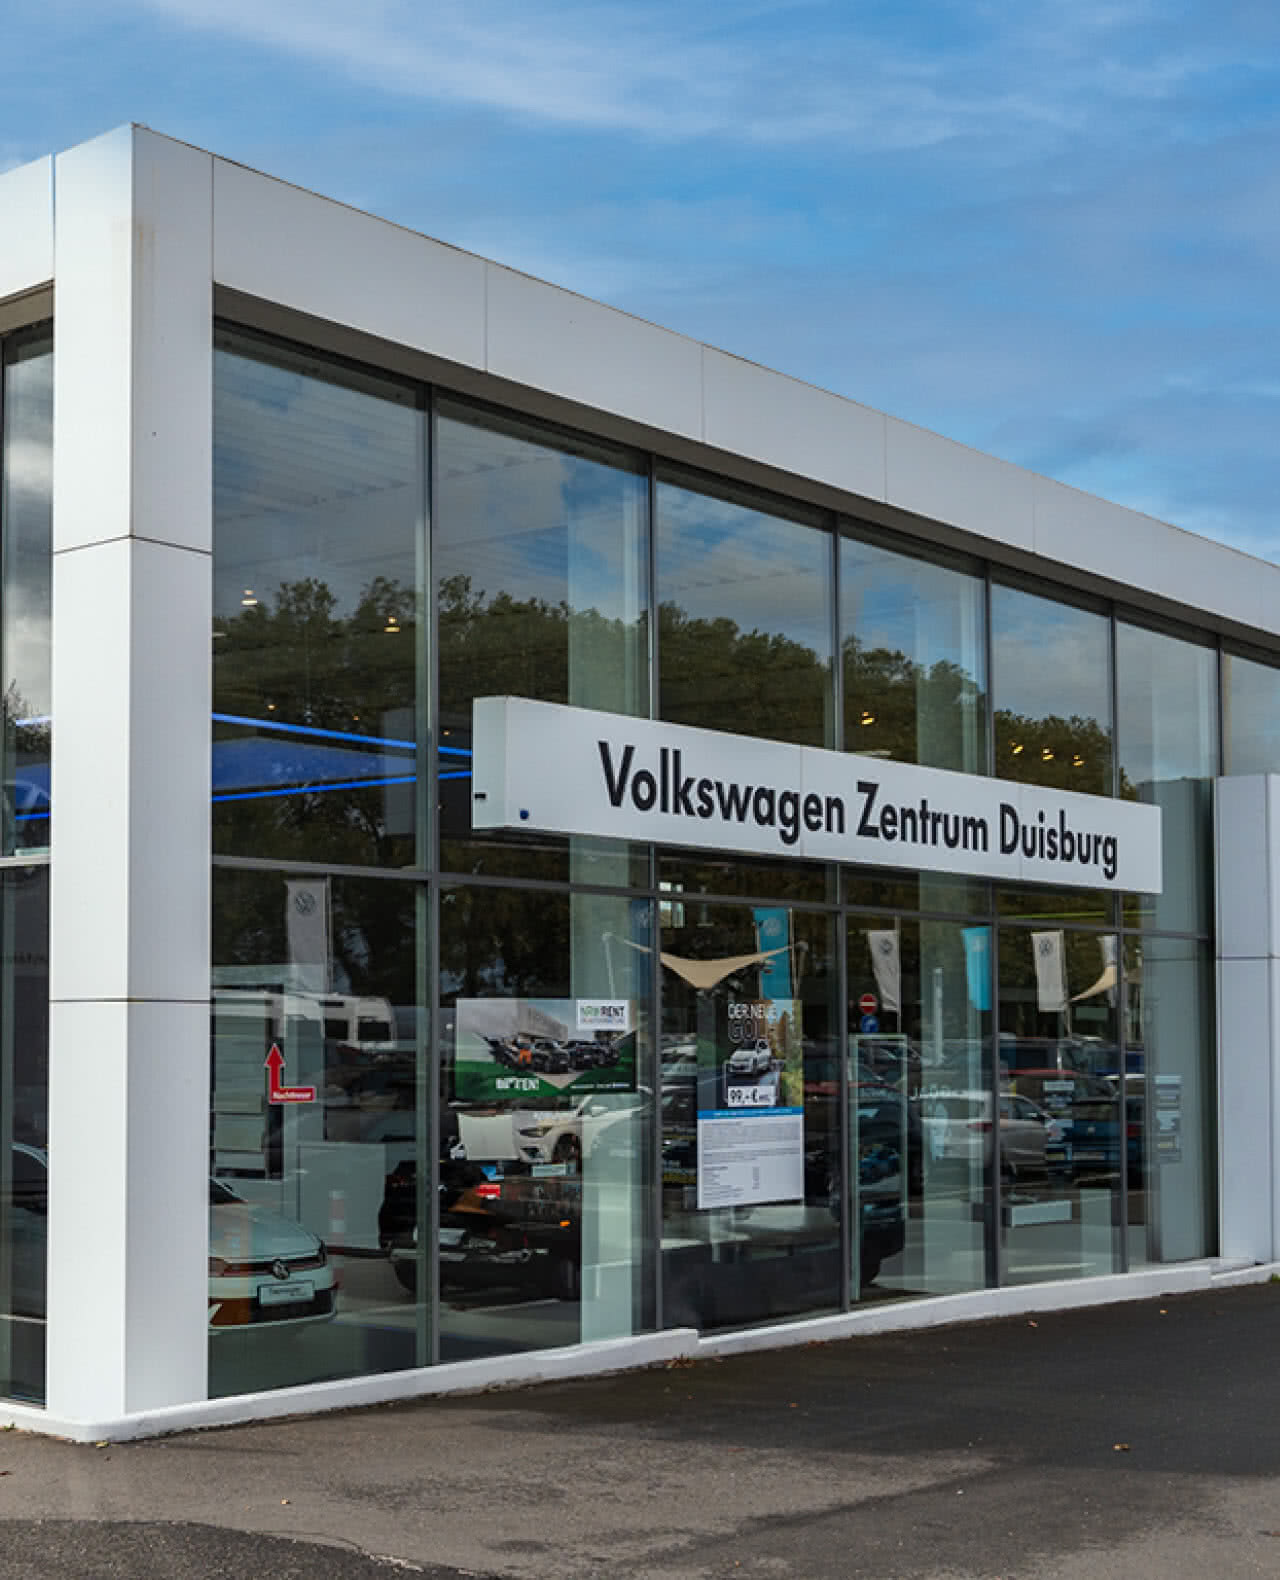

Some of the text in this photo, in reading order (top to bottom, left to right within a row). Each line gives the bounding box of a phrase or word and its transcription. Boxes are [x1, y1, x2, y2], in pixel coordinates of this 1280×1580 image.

[598, 740, 1118, 881] Volkswagen Zentrum Duisburg
[728, 1003, 751, 1019] DER
